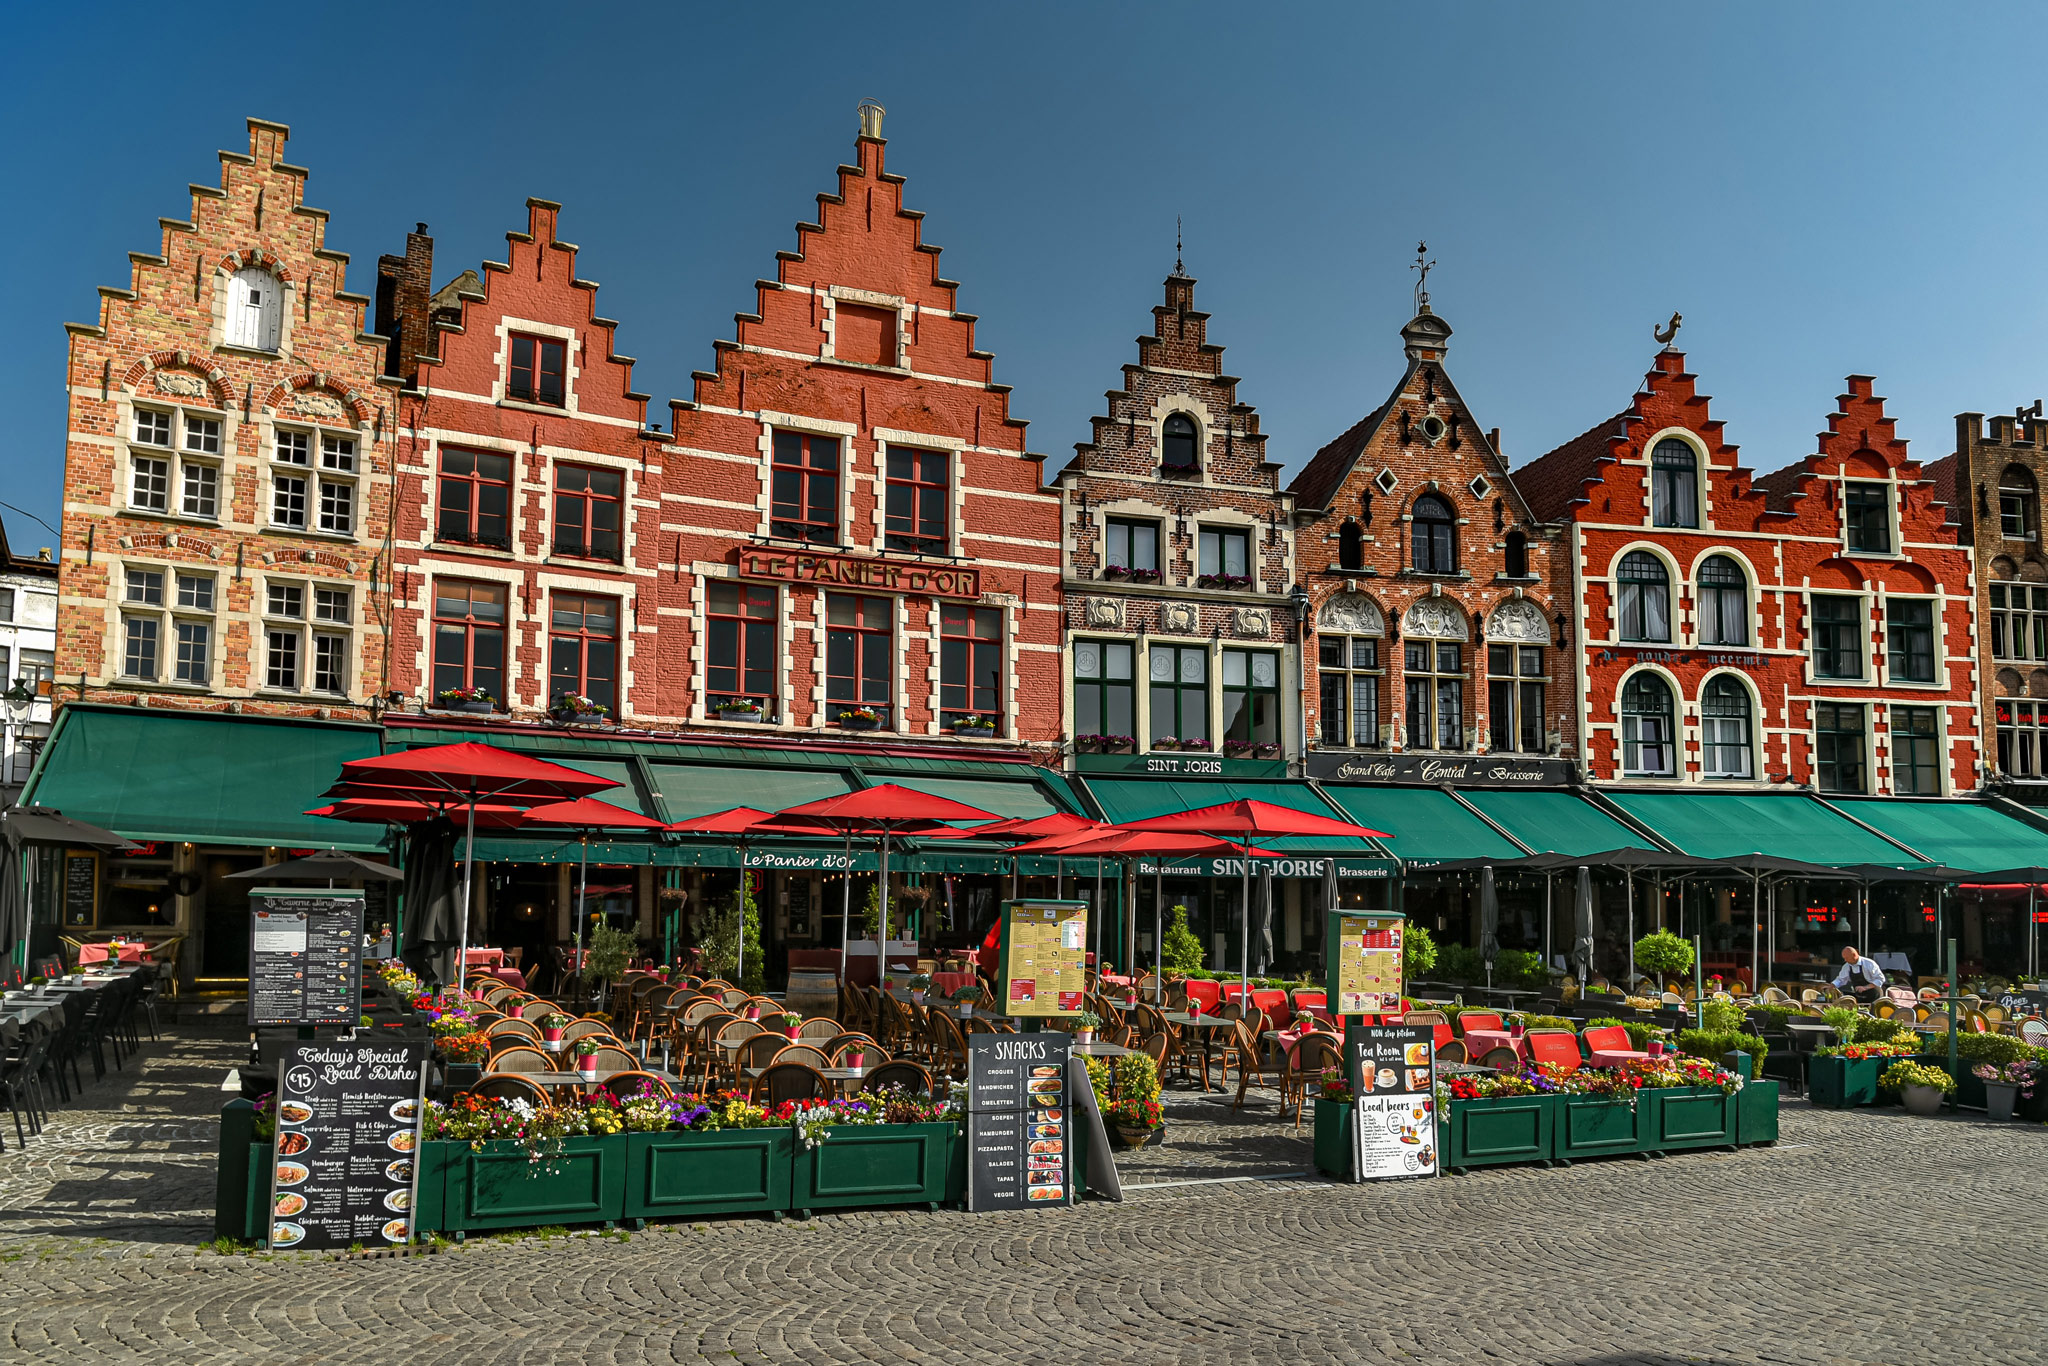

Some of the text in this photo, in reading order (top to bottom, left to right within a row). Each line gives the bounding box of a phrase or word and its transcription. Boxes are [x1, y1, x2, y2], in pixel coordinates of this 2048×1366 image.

[752, 556, 975, 595] LE PANIER D'OR
[1707, 653, 1769, 666] meermin
[1147, 759, 1222, 773] SINT JORIS
[1337, 762, 1373, 779] Grand
[1420, 758, 1467, 781] Central
[1488, 767, 1544, 781] Brasserie
[744, 852, 856, 868] Le Panier d'Or
[1212, 858, 1325, 877] SINT JORIS
[1338, 866, 1388, 877] Brasserie
[2001, 995, 2028, 1007] Beer
[1370, 1028, 1416, 1039] NON stop kitchen
[298, 1047, 409, 1068] Today's Special
[994, 1041, 1046, 1060] SNACKS
[1357, 1042, 1401, 1057] Tea Room
[289, 1072, 311, 1088] €15
[320, 1064, 418, 1085] Local Dishes
[1362, 1098, 1410, 1113] Local beers
